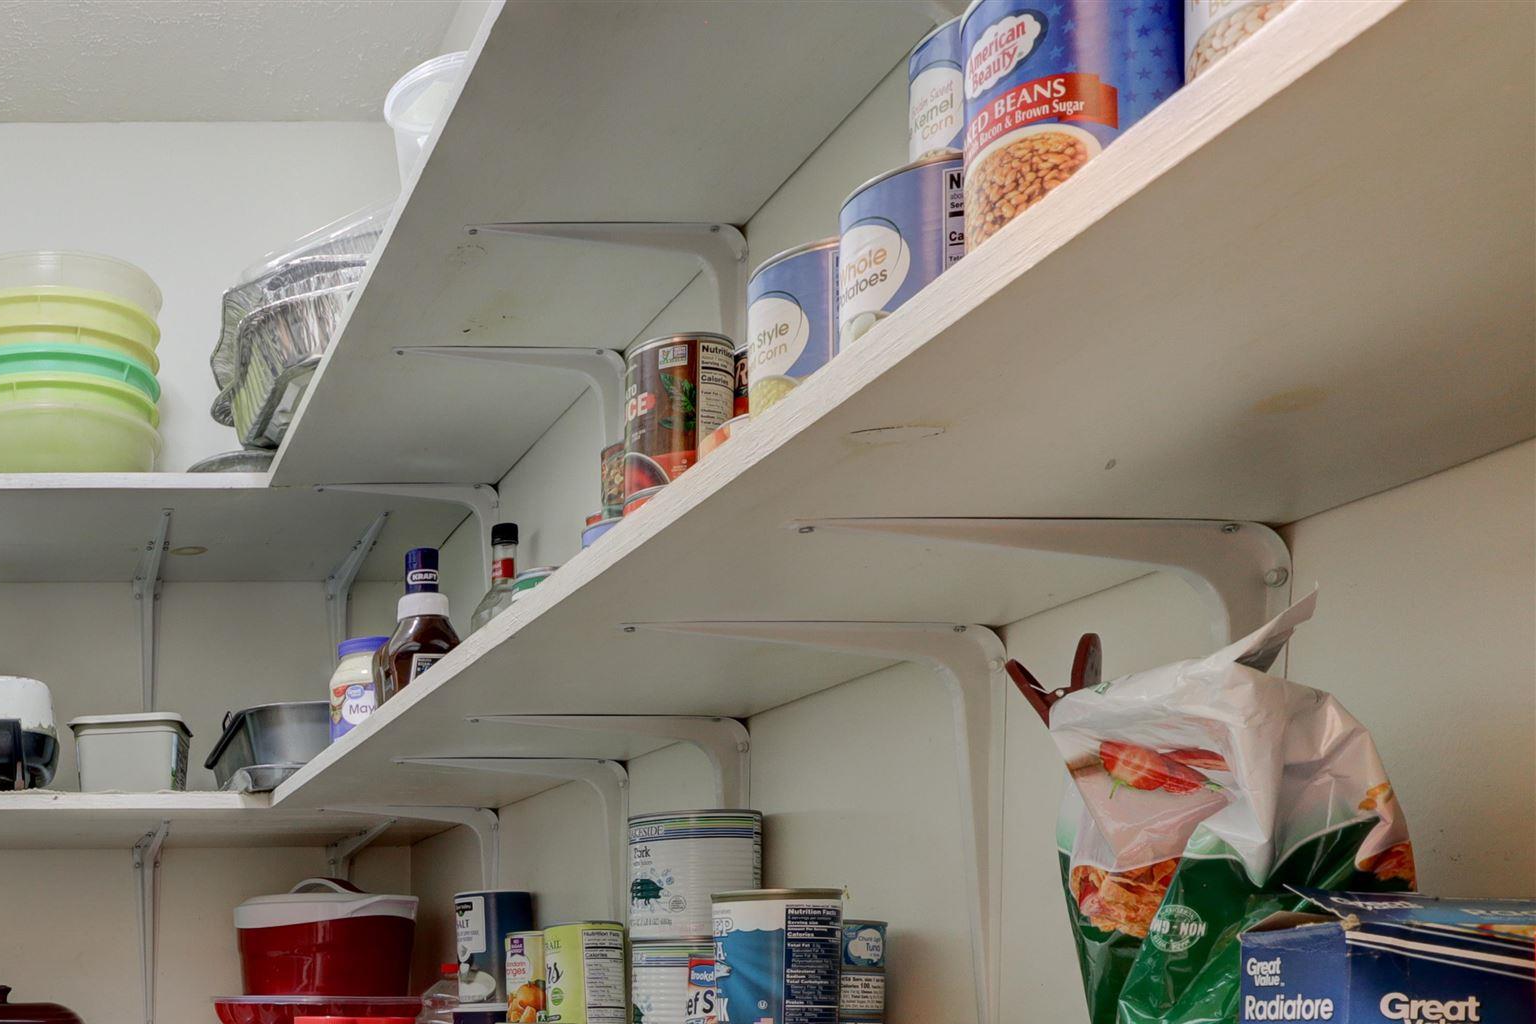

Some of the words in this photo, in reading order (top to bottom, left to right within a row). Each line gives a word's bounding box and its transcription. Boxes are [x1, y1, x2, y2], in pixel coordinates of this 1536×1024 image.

[968, 21, 1027, 80] American
[970, 41, 1019, 93] Beauty
[994, 78, 1067, 116] BEANS
[913, 93, 955, 133] Kernel
[979, 122, 1003, 148] Bacon
[1004, 114, 1013, 129] &
[1014, 103, 1050, 124] Brown
[1052, 99, 1086, 118] Sugar
[921, 115, 955, 142] Corn
[756, 322, 790, 348] Style
[757, 343, 788, 366] Corn
[700, 374, 730, 386] Calories
[411, 571, 438, 582] KRAFT
[787, 908, 822, 917] Nutrition
[866, 942, 881, 952] Tuna
[1246, 957, 1282, 977] Great
[1254, 974, 1281, 987] Value
[1244, 994, 1334, 1021] Radiatore
[1379, 991, 1481, 1023] Great
